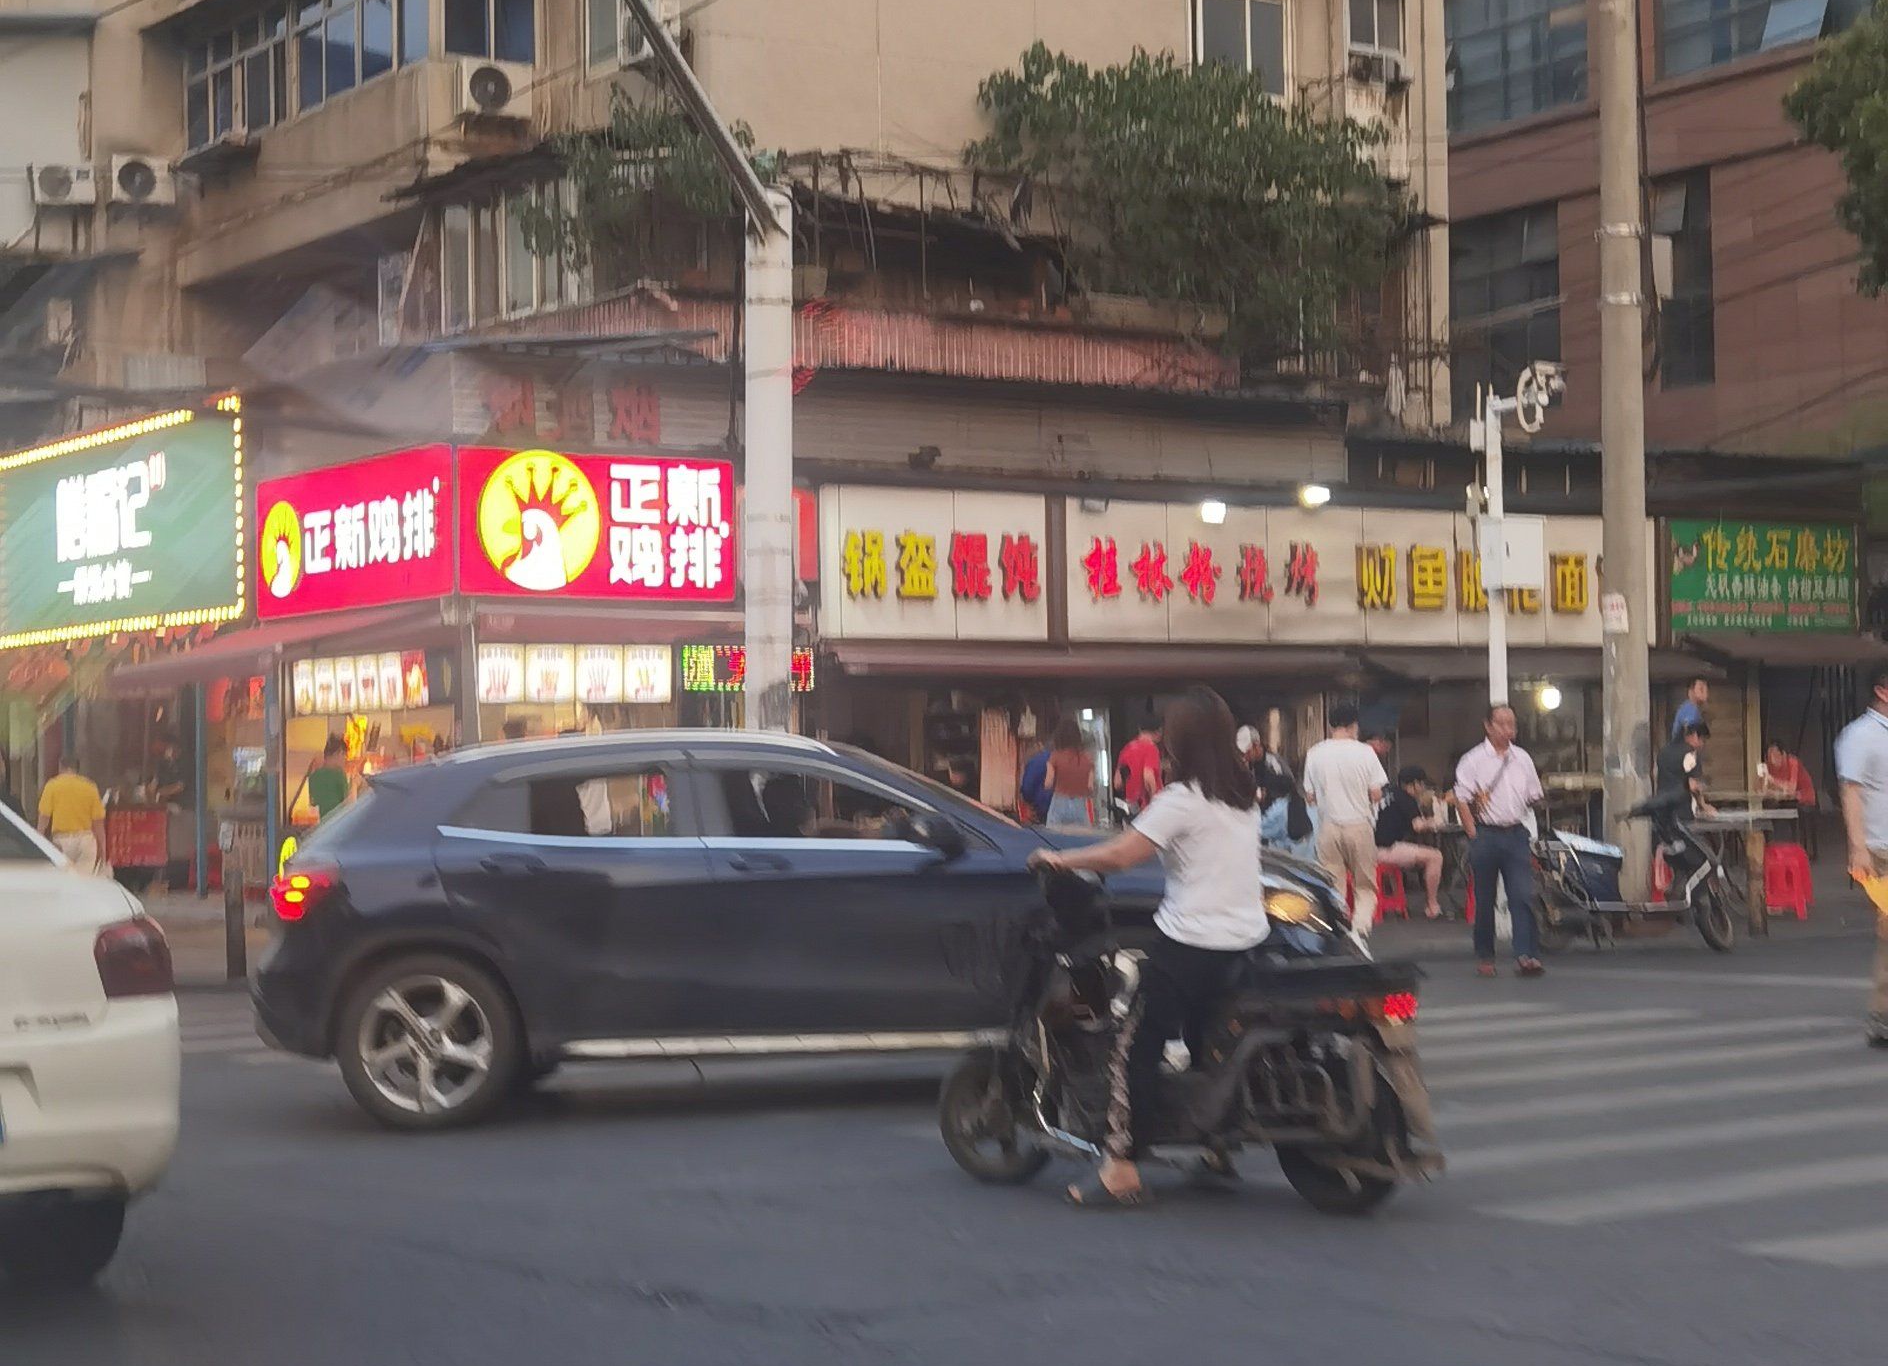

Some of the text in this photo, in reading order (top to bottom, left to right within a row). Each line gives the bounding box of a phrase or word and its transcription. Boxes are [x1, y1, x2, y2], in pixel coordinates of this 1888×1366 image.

[609, 463, 722, 526] 正新
[303, 487, 436, 574] 正新鸡排
[609, 525, 722, 589] 鸡排
[842, 528, 1041, 600] 锅盔馄饨
